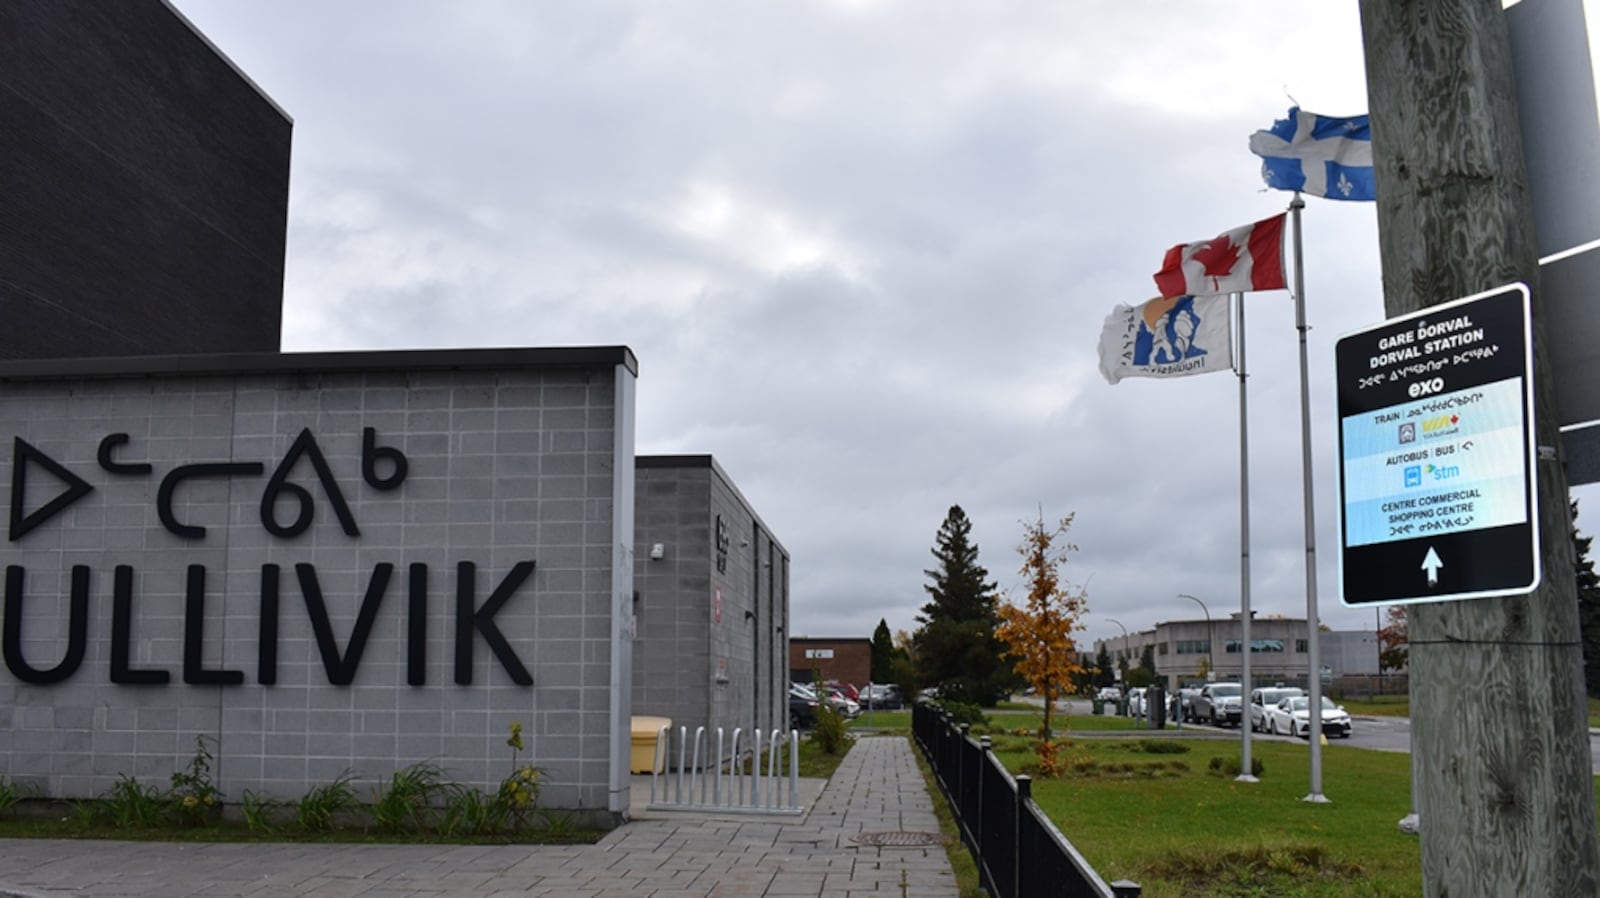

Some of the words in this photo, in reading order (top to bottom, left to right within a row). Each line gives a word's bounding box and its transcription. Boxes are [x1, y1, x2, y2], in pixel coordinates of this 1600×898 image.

[1378, 331, 1415, 350] GARE
[1417, 315, 1473, 340] DORVAL
[1369, 346, 1422, 369] DORVAL
[1424, 328, 1484, 355] STATION
[1408, 377, 1444, 398] exo
[1374, 412, 1400, 424] TRAIN
[1386, 450, 1429, 466] AUTOBUS
[1435, 445, 1455, 457] BUS
[1434, 465, 1459, 480] stm
[1381, 499, 1416, 513] CENTRE
[1418, 488, 1481, 506] COMMERCIAL
[1388, 508, 1435, 523] SHOPPING
[1436, 502, 1474, 516] CENTRE
[2, 560, 536, 686] ULLIVIK
